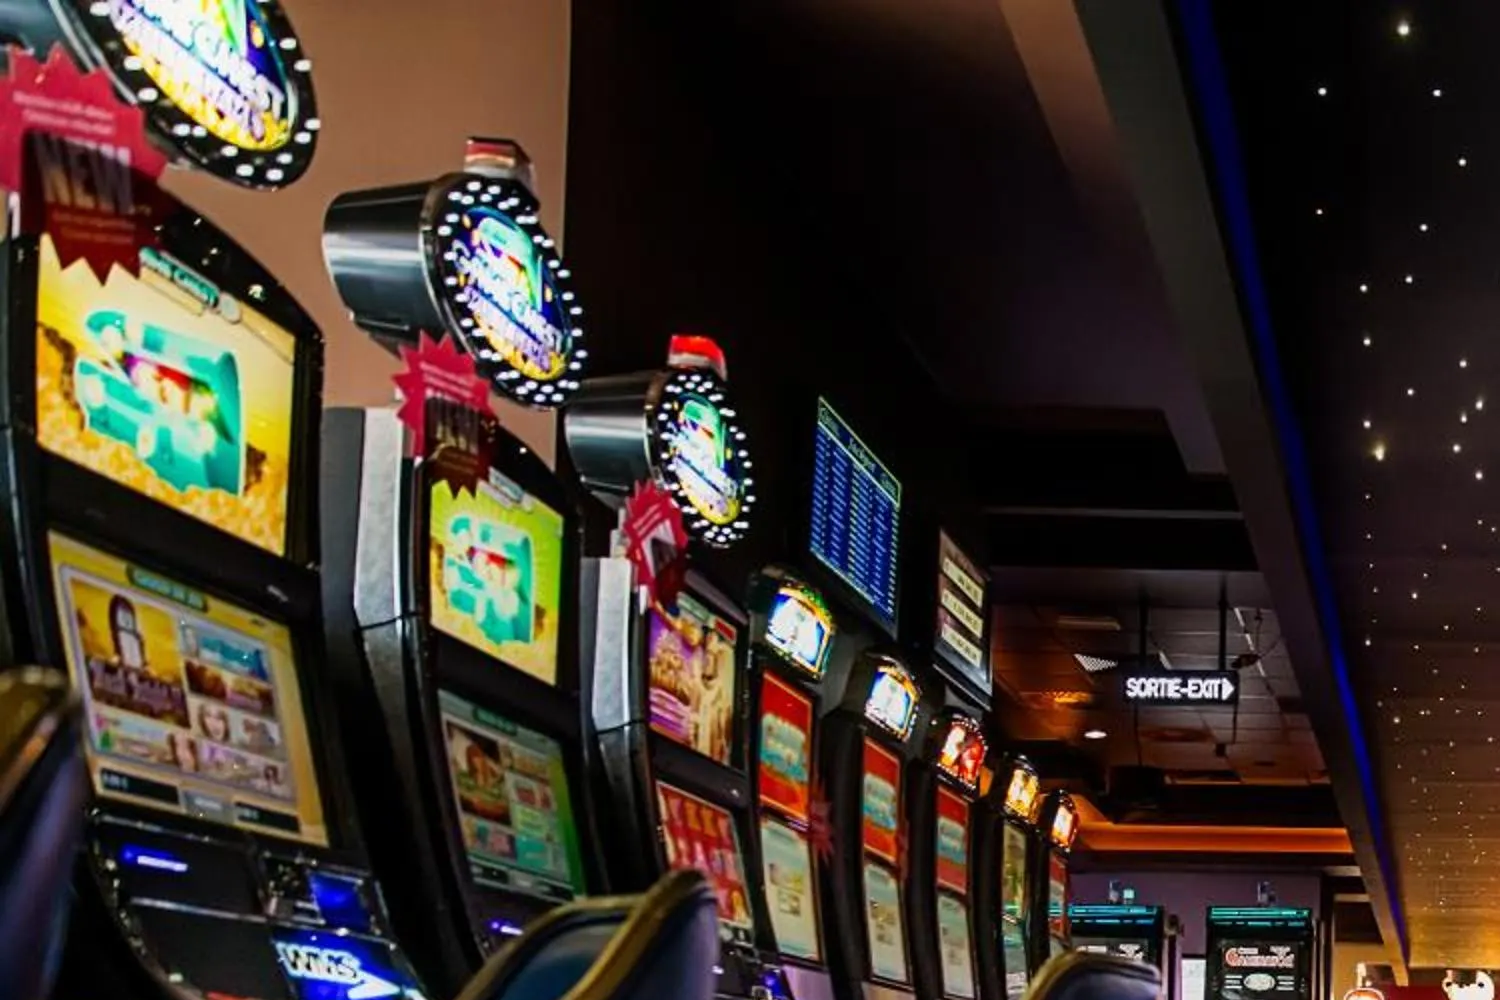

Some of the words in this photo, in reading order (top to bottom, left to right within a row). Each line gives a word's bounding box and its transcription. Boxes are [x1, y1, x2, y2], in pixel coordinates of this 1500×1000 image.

[36, 131, 133, 215] NEW
[1126, 678, 1221, 699] SORTIE-EXIT
[276, 942, 361, 984] WMS
